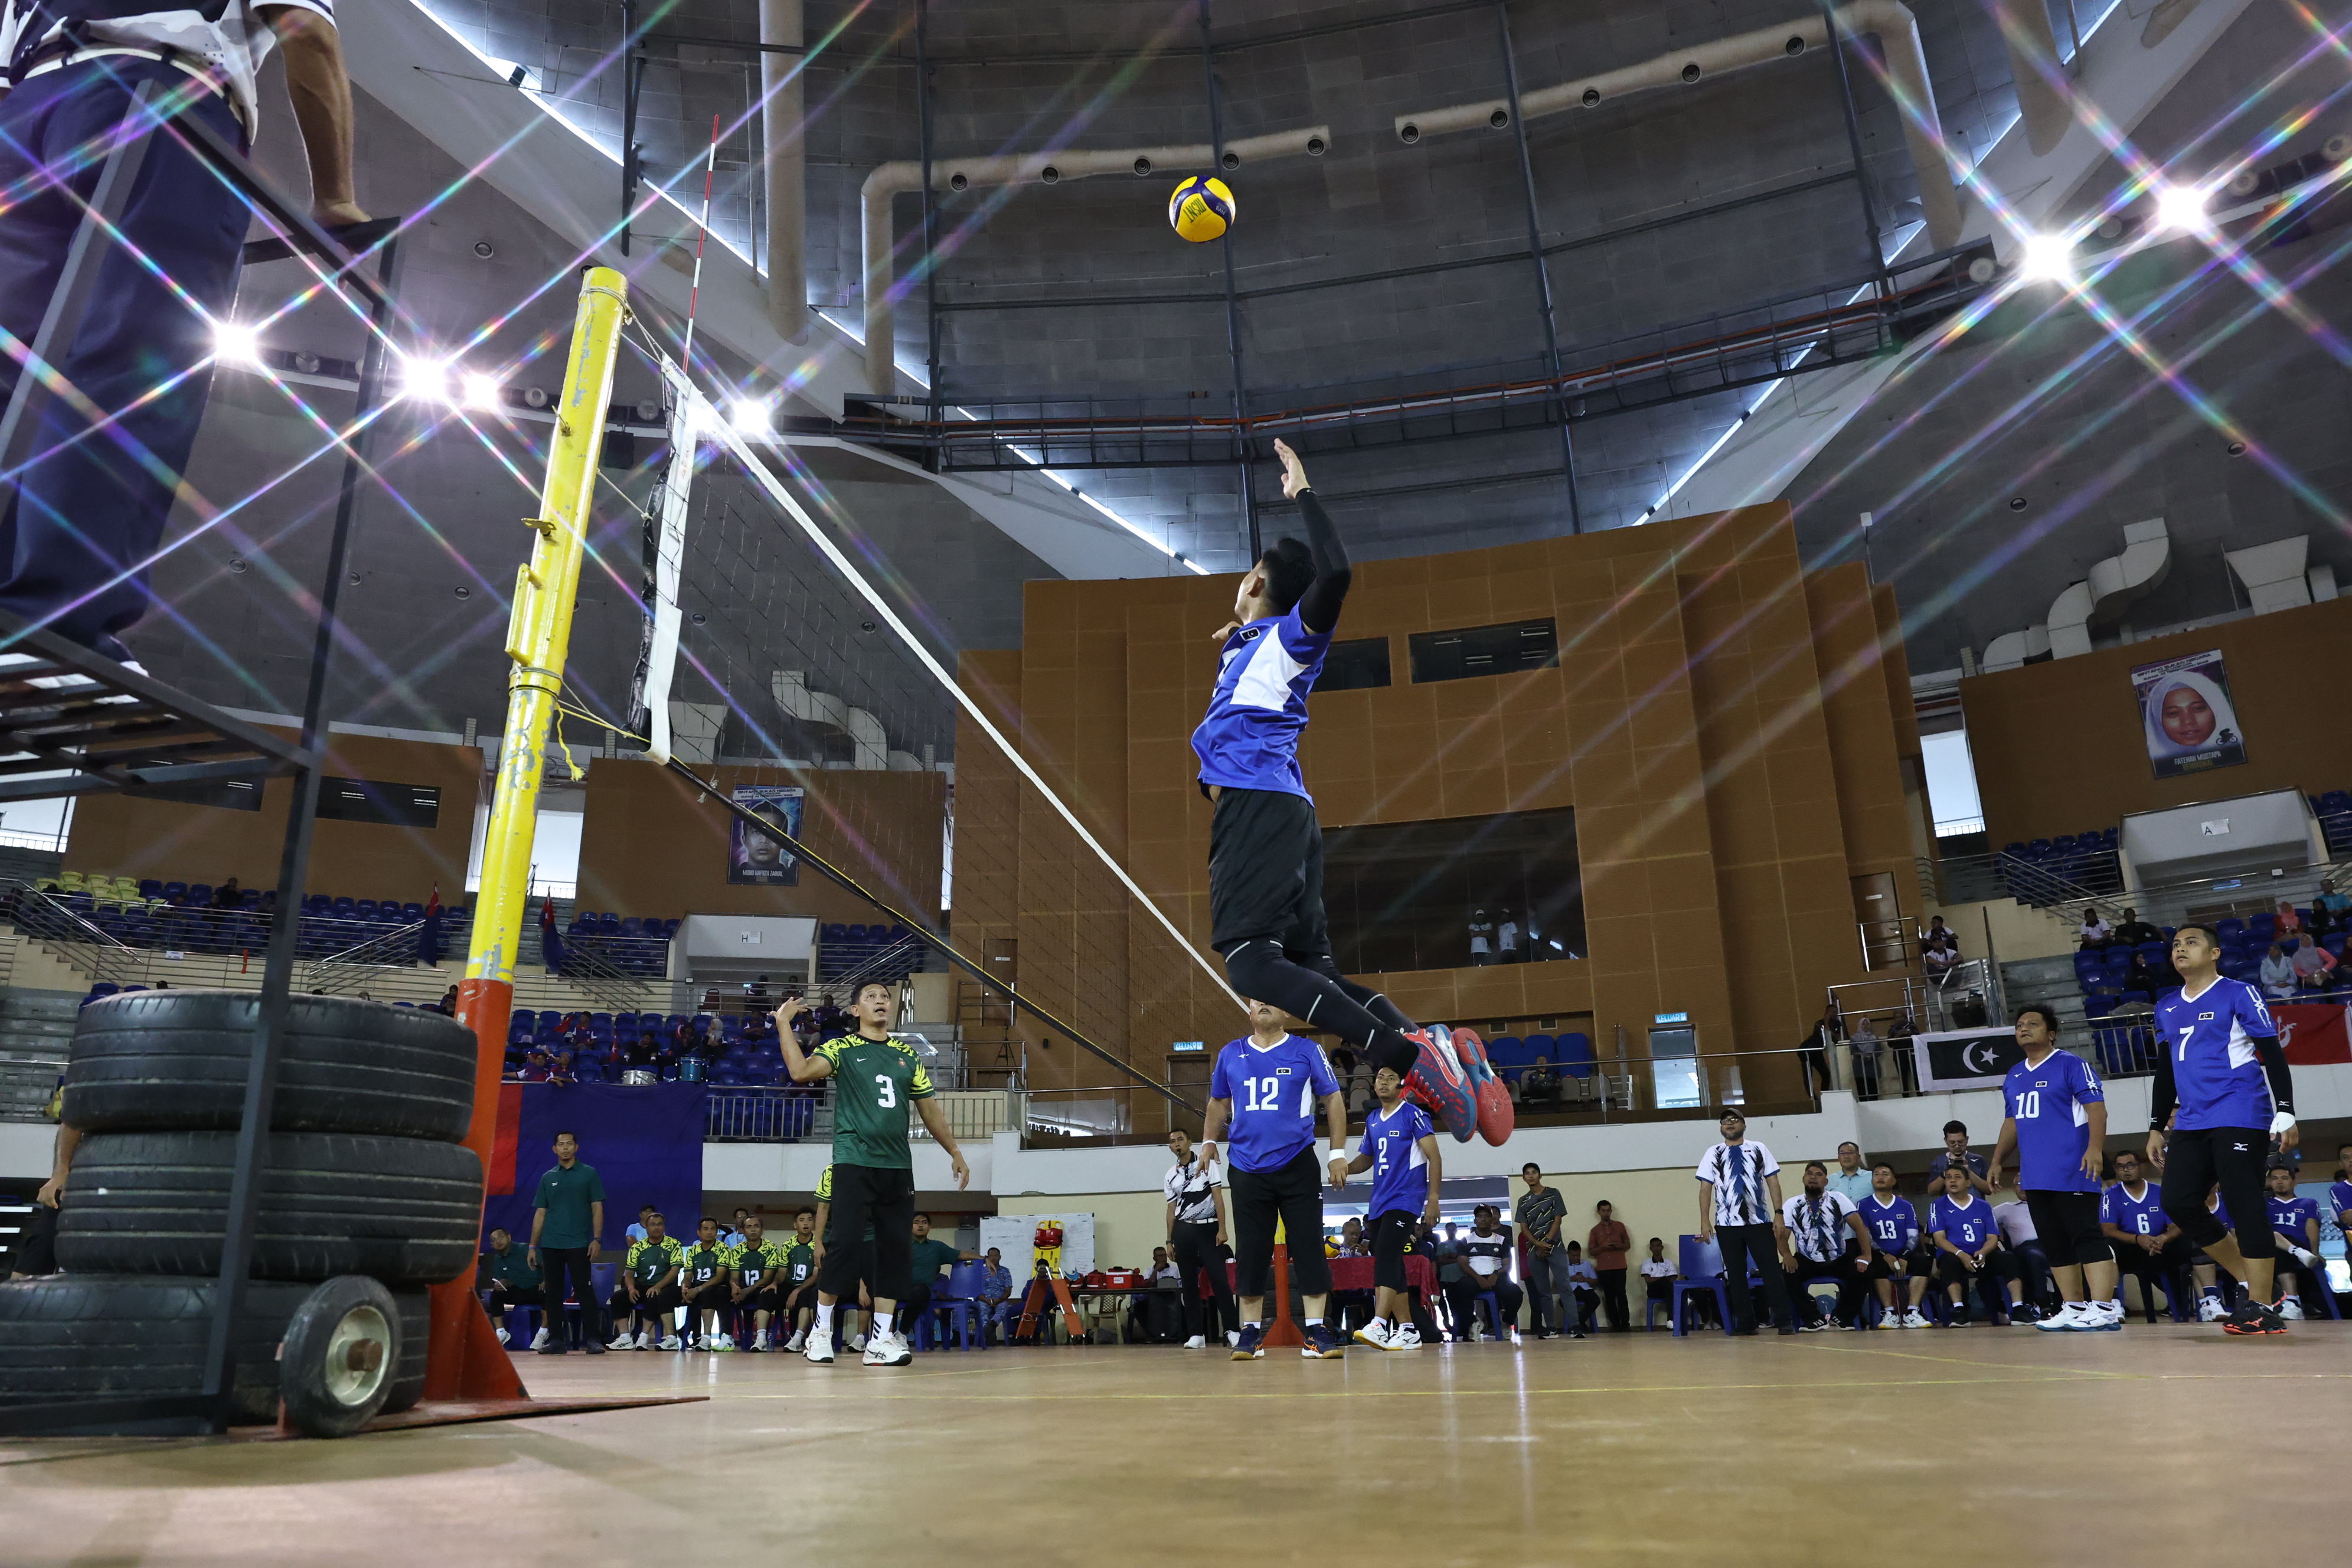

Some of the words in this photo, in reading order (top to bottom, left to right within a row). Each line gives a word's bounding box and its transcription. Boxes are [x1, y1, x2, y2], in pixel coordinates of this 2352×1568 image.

[2186, 653, 2211, 663] NEGARA
[2174, 755, 2196, 765] FATEHAH
[2197, 750, 2222, 761] MUSTAPA
[2205, 827, 2213, 835] A
[1657, 1014, 1680, 1023] KELUAR
[2179, 1025, 2194, 1061] 7
[876, 1074, 896, 1108] 3
[1244, 1077, 1279, 1111] 12
[2015, 1091, 2039, 1119] 10
[1378, 1137, 1387, 1163] 2
[2137, 1213, 2150, 1234] 6
[2274, 1212, 2296, 1227] 11
[1876, 1220, 1896, 1239] 13
[1963, 1223, 1975, 1242] 3
[647, 1265, 656, 1280] 7
[744, 1270, 760, 1286] 12
